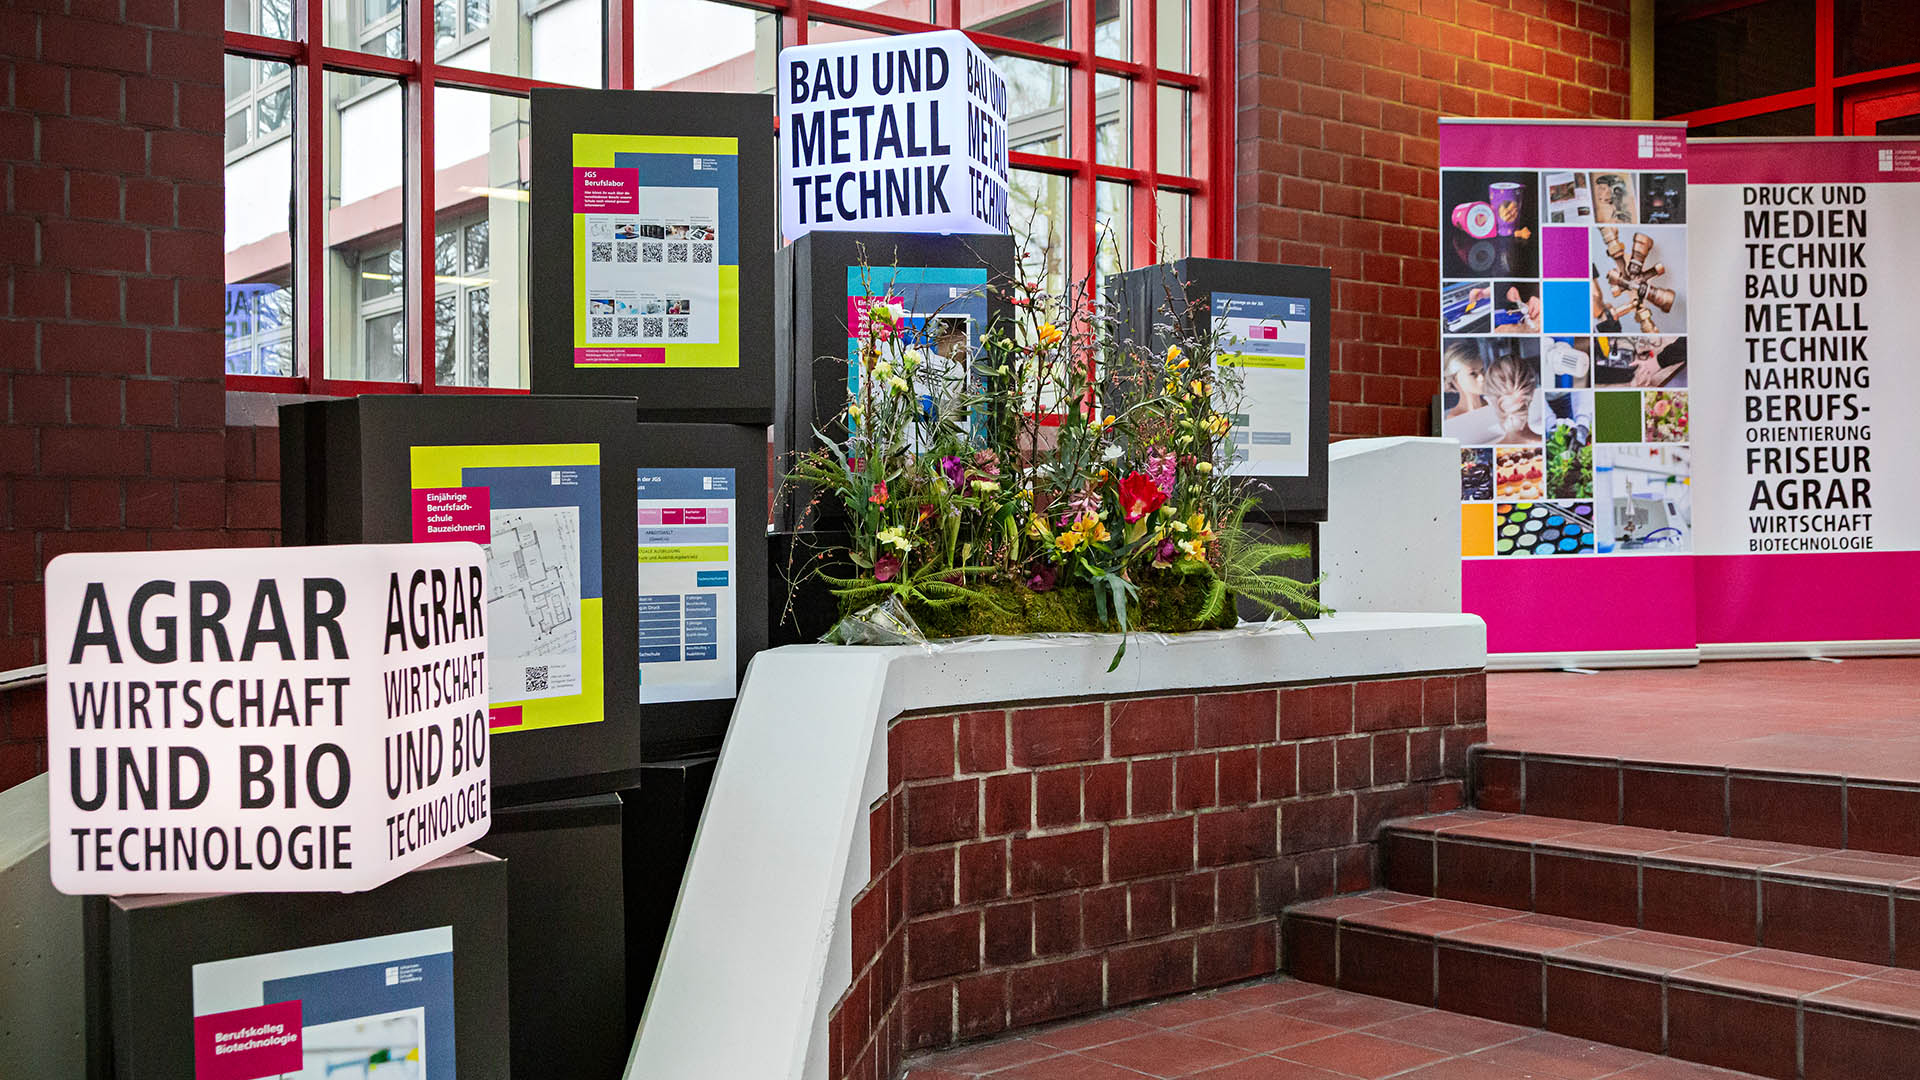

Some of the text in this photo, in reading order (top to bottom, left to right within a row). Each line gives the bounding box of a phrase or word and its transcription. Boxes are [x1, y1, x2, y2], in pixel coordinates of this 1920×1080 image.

[791, 47, 949, 104] BAU UND
[967, 48, 1007, 122] BAU UND
[791, 100, 951, 168] METALL
[968, 101, 1008, 183] METALL
[792, 164, 951, 224] TECHNIK
[969, 165, 1009, 235] TECHNIK
[1743, 186, 1866, 205] DRUCK UND
[1744, 210, 1867, 239] MEDIEN
[1745, 243, 1866, 269] TECHNIK
[1745, 273, 1868, 299] BAU UND
[1745, 303, 1868, 332] METALL
[1745, 336, 1868, 363] TECHNIK
[1745, 366, 1870, 390] NAHRUNG
[1745, 394, 1870, 422] BERUFS-
[1746, 425, 1871, 442] ORIENTIERUNG
[1747, 446, 1871, 474] FRISEUR
[427, 493, 467, 503] Einjährige
[427, 503, 472, 512] Berufsfach-
[1749, 478, 1872, 511] AGRAR
[427, 514, 453, 522] schule
[427, 523, 486, 533] Bauzeichner:in
[1750, 514, 1872, 533] WIRTSCHAFT
[1750, 536, 1873, 551] BIOTECHNOLOGIE
[69, 577, 350, 665] AGRAR
[384, 566, 484, 655] AGRAR
[384, 652, 484, 719] WIRTSCHAFT
[69, 677, 351, 729] WIRTSCHAFT
[385, 709, 486, 800] UND BIO
[70, 743, 351, 811] UND BIO
[386, 779, 487, 861] TECHNOLOGIE
[71, 825, 352, 872] TECHNOLOGIE
[215, 1023, 284, 1043] Berufskolleg
[215, 1033, 297, 1055] Biotechnologie
